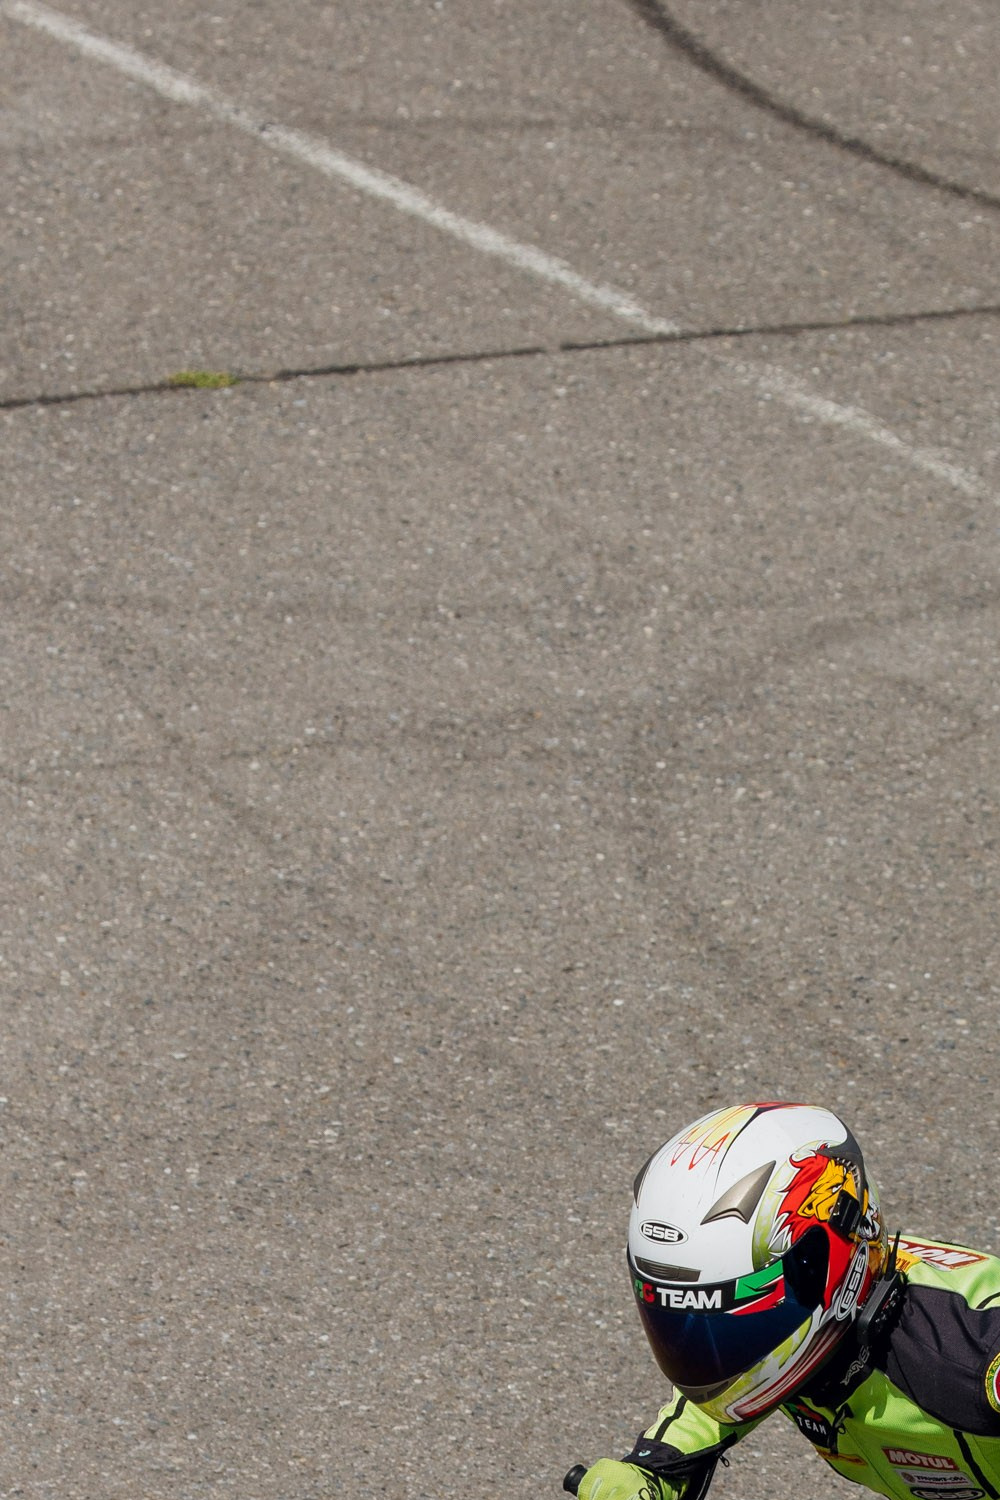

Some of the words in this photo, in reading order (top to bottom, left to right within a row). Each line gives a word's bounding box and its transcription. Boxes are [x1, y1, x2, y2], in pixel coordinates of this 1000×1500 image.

[642, 1224, 679, 1241] GSB
[842, 1253, 866, 1309] GSB
[656, 1287, 722, 1310] TEAM
[889, 1449, 954, 1469] MOTUL
